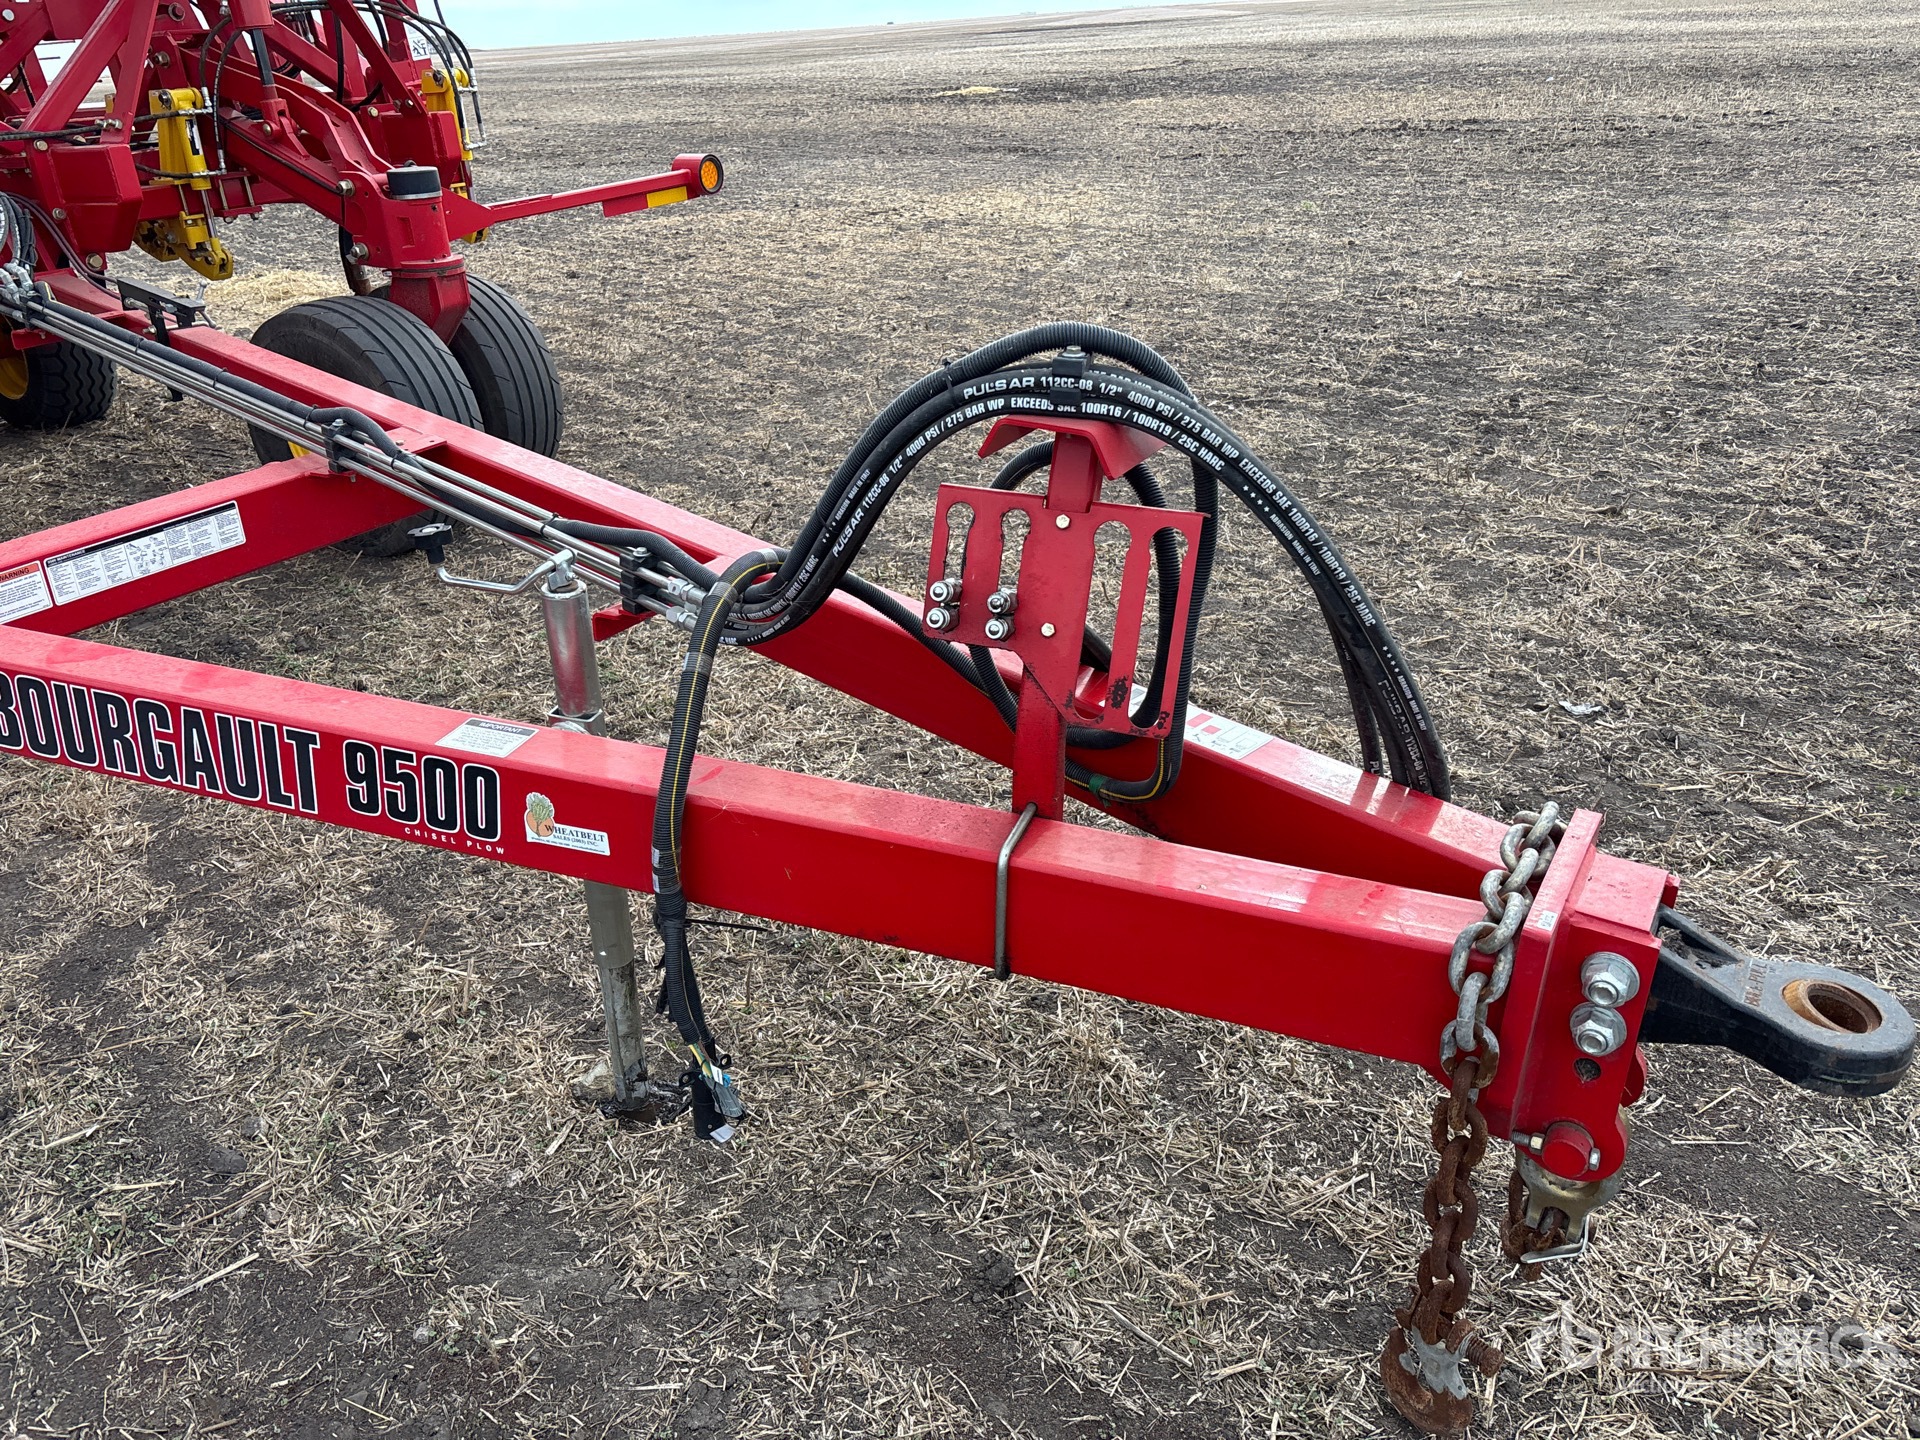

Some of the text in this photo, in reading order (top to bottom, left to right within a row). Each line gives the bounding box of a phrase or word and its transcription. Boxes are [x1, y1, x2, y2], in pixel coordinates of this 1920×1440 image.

[832, 508, 865, 557] PULSAR
[862, 473, 890, 509] 112CC-08
[905, 435, 927, 458] 4000
[924, 424, 941, 442] PSI
[946, 411, 963, 428] 275
[965, 402, 986, 419] BAR
[987, 398, 1005, 411] WP
[1010, 397, 1054, 411] EXCEEDS
[1080, 401, 1123, 417] 100R16
[1132, 410, 1173, 436] 100R19
[1177, 434, 1200, 452] 2SC
[1198, 446, 1226, 471] HARC
[963, 376, 1035, 400] PULSAR
[1040, 376, 1094, 391] 112CC-08
[1099, 379, 1123, 396] 1/2"
[1127, 390, 1156, 409] 4000
[1155, 401, 1175, 418] PSI
[1181, 415, 1202, 432] 275
[1200, 427, 1223, 448] BAR
[1221, 442, 1240, 460] WP
[1239, 457, 1277, 494] EXCEEDS
[1272, 490, 1292, 511] SAE
[1288, 507, 1319, 542] 100R16
[1318, 546, 1347, 581] 100R19
[1355, 602, 1377, 627] HARC
[1269, 512, 1322, 576] ABRASION MADE IN ITALY
[479, 721, 524, 734] IMPORTANT
[343, 739, 501, 842] 9500
[405, 827, 505, 855] CHISEL PLOW
[544, 824, 605, 842] WHEATBELT
[553, 834, 570, 842] SALES
